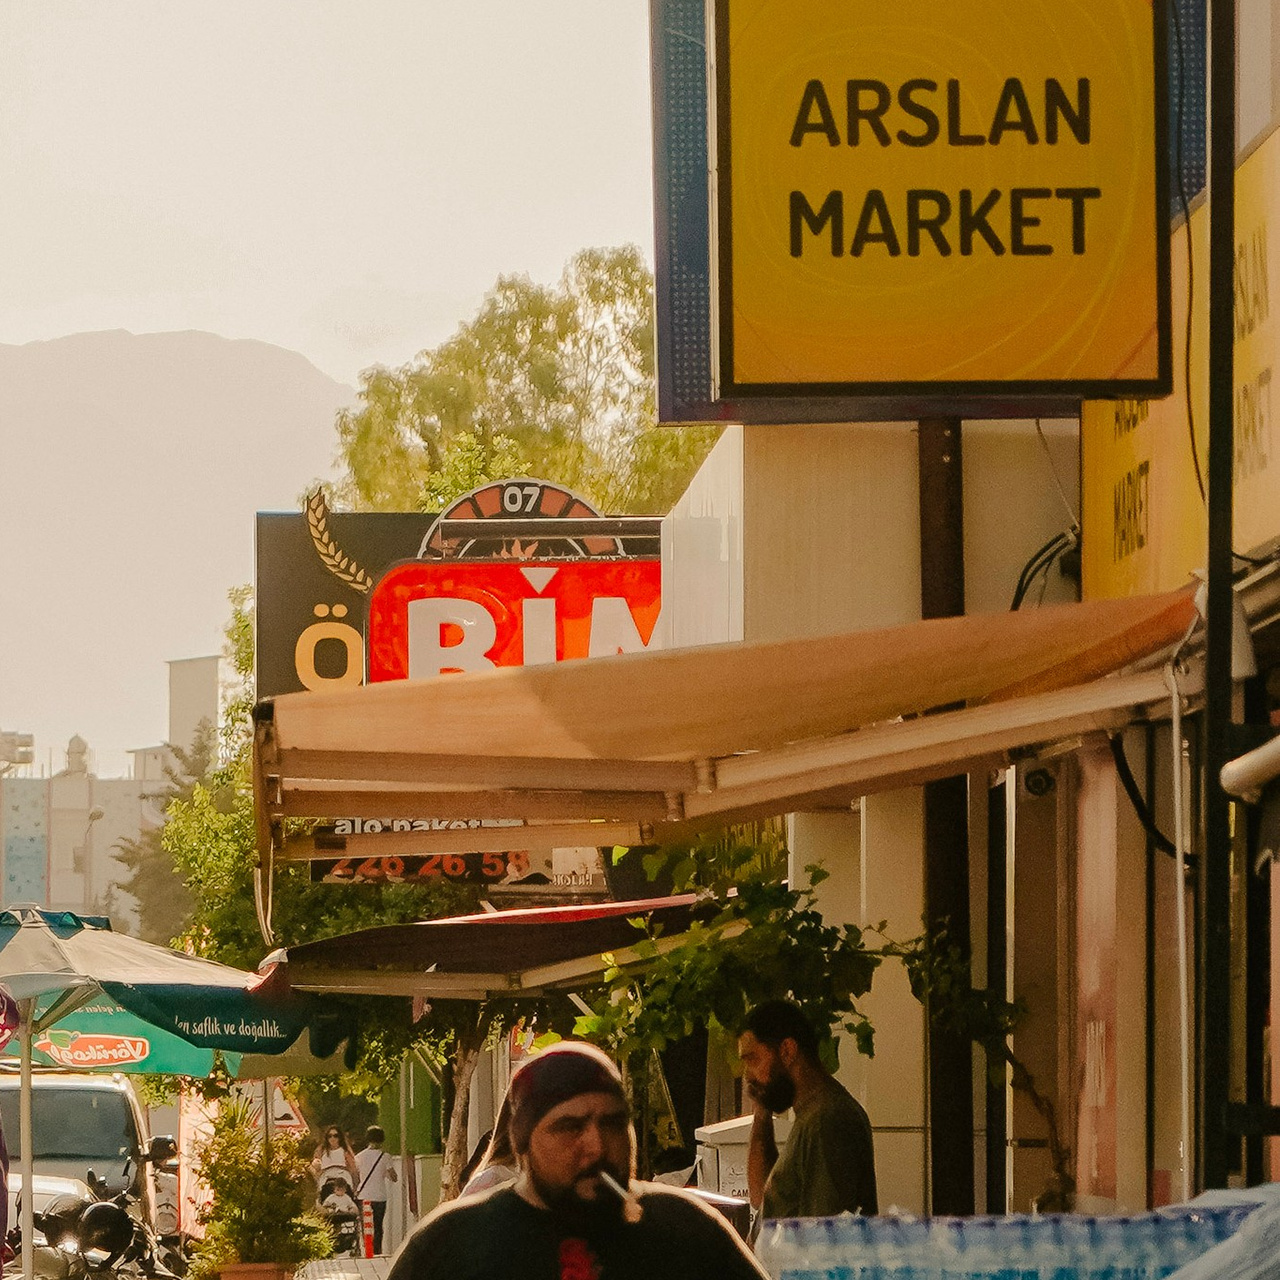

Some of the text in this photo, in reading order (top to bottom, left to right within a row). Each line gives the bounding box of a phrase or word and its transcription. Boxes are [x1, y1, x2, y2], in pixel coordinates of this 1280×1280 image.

[788, 76, 1092, 148] ARSLAN
[788, 186, 1101, 258] MARKET
[504, 485, 541, 513] 07
[407, 567, 662, 680] BİM
[334, 818, 383, 835] alo
[192, 1016, 221, 1037] saflık
[223, 1023, 237, 1035] ve
